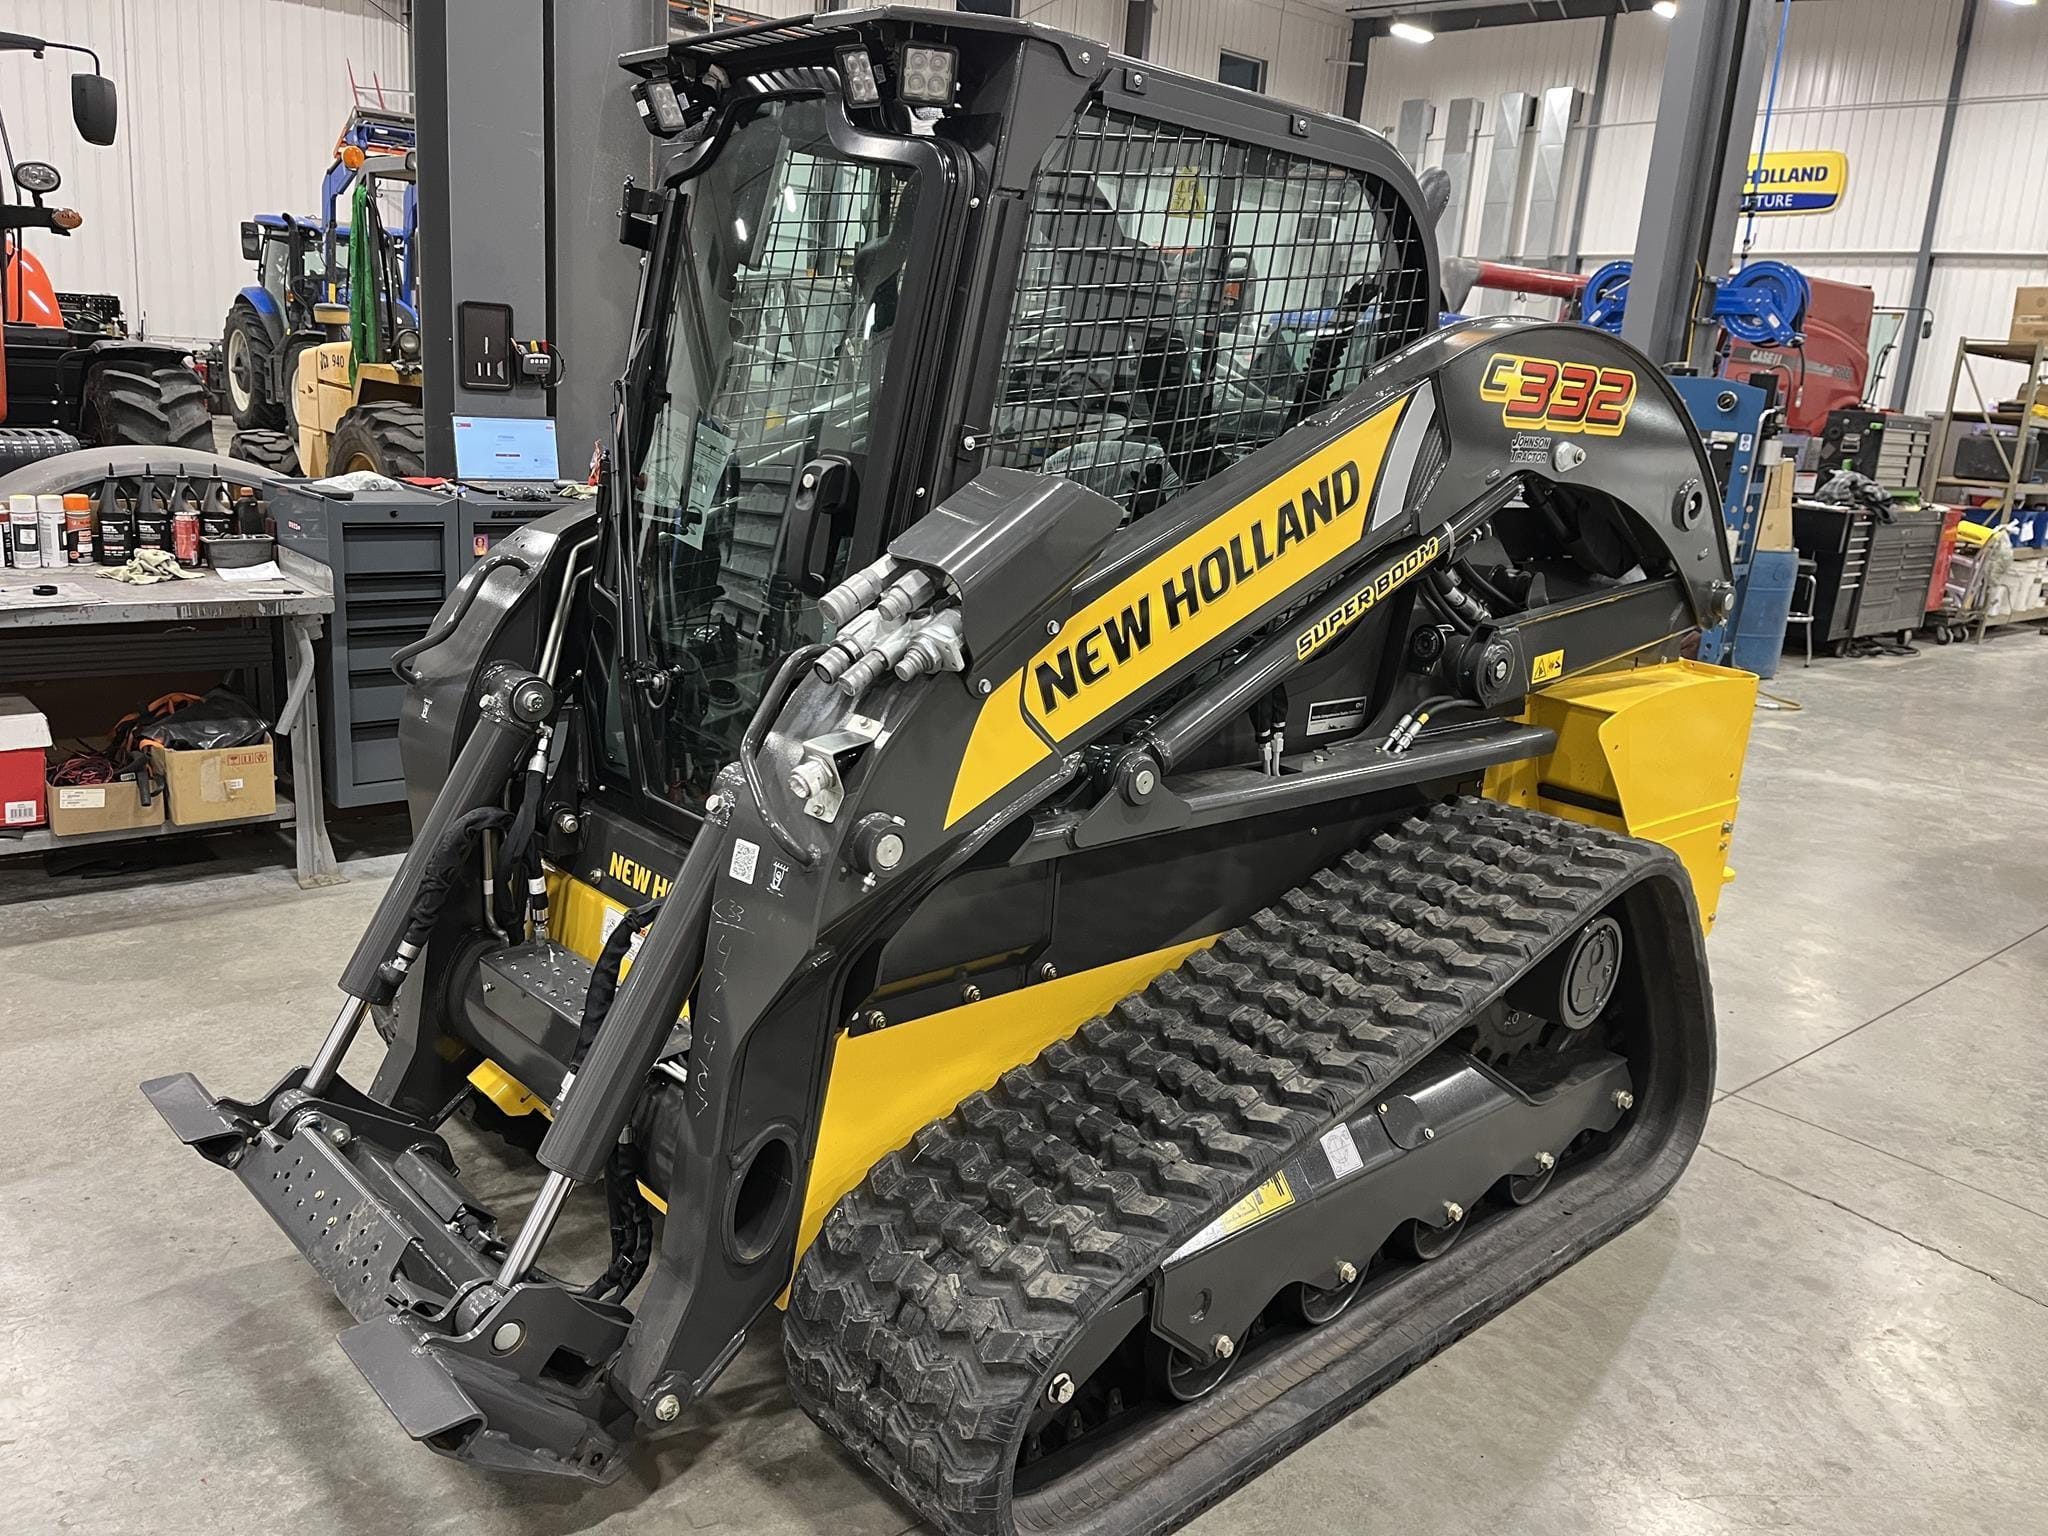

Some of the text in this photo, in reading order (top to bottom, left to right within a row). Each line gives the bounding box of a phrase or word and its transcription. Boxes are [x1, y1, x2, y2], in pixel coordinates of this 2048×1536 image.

[1741, 194, 1793, 207] TURE
[1483, 355, 1635, 432] C332
[1510, 448, 1548, 463] TRACTOR
[1511, 431, 1551, 449] JOHNSON
[1034, 461, 1360, 715] NEW HOLLAND
[1297, 537, 1438, 659] SUPER BOOM
[609, 851, 673, 900] NEW H
